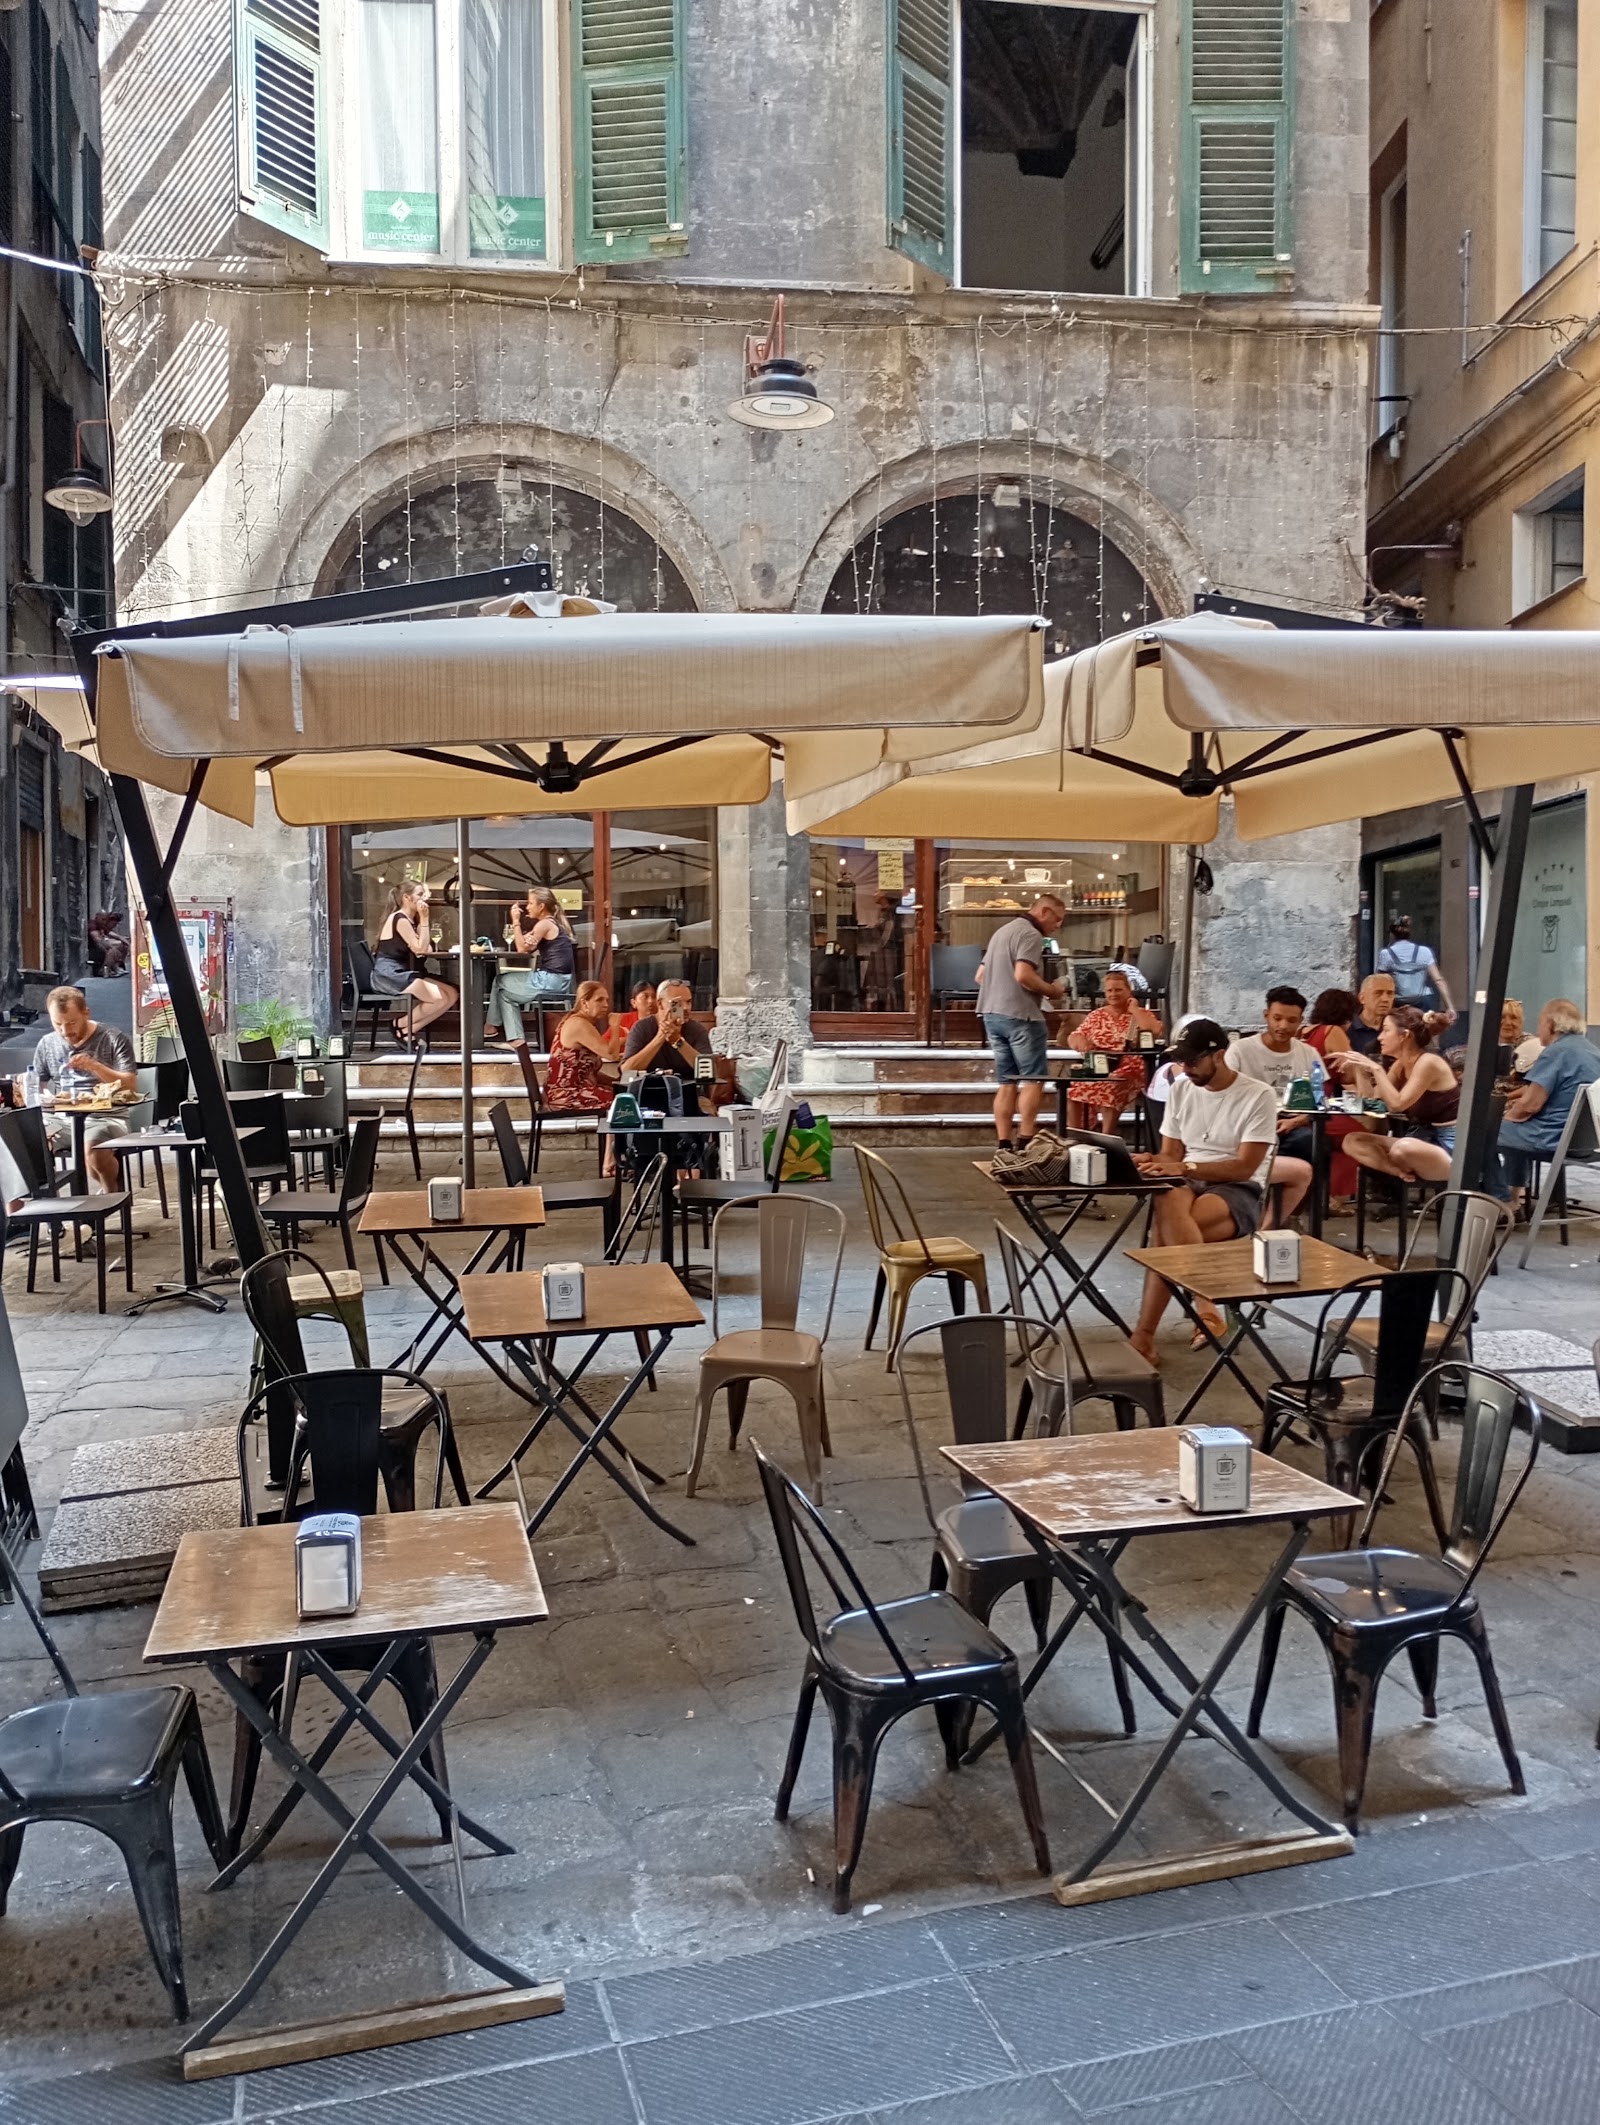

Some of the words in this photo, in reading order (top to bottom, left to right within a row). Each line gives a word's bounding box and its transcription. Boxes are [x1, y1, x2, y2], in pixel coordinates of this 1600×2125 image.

[368, 230, 399, 241] music
[401, 233, 436, 242] center
[508, 237, 542, 247] center
